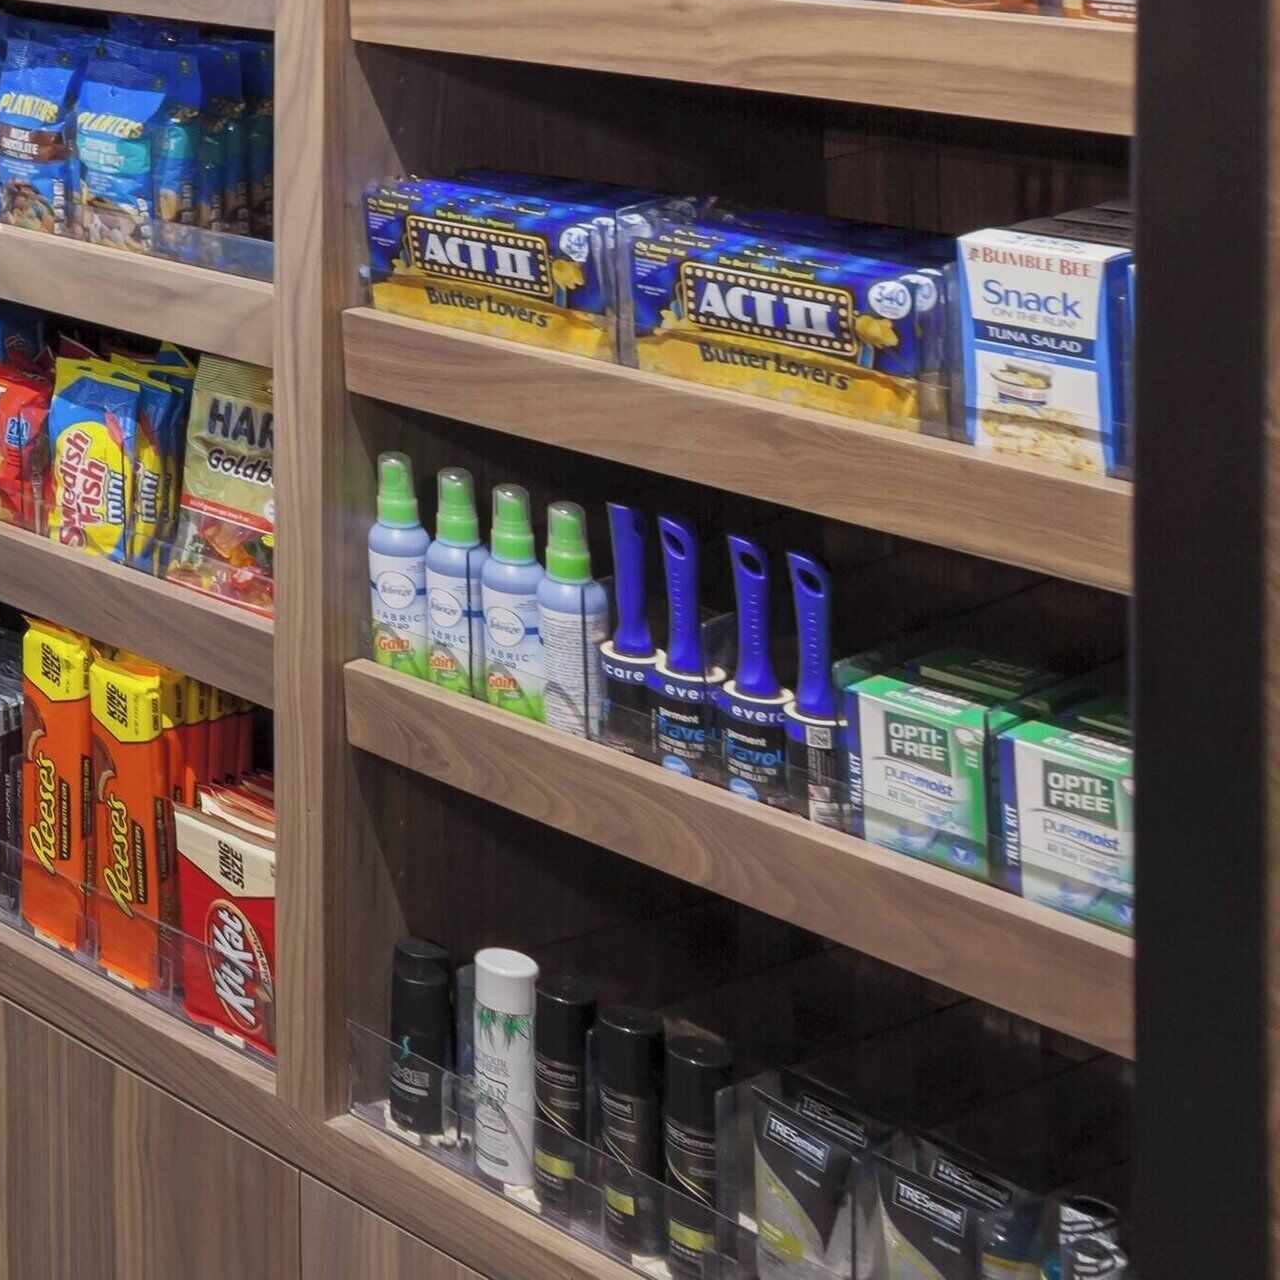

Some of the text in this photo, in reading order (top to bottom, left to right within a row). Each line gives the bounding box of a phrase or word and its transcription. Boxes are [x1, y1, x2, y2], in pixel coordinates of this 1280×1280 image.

[0, 92, 58, 123] PLANTERS
[982, 247, 1092, 278] BUMBLE BEE
[426, 287, 549, 329] Butter Lovers
[982, 279, 1083, 320] Snack
[986, 326, 1083, 353] TUNA SALAD
[700, 341, 849, 392] Butter Lovers
[59, 430, 91, 546] Swedish
[78, 459, 107, 525] Fish
[105, 471, 123, 524] mini
[41, 642, 52, 680] KING
[379, 636, 410, 652] Gain
[51, 648, 62, 687] SIZE
[488, 673, 517, 691] Gain
[106, 681, 117, 719] KING
[116, 688, 128, 727] SIZE
[889, 722, 944, 746] OPTI-
[891, 739, 945, 761] FREE
[849, 753, 861, 775] KIT
[885, 766, 954, 797] puremoist
[1047, 772, 1108, 797] OPTI-
[1050, 791, 1111, 814] FREE
[28, 750, 57, 876] Reese's
[1004, 803, 1021, 867] TRIAL KIT
[1043, 817, 1120, 852] puremoist
[103, 792, 134, 918] Reese's
[218, 840, 233, 882] KING
[231, 847, 245, 889] SIZE
